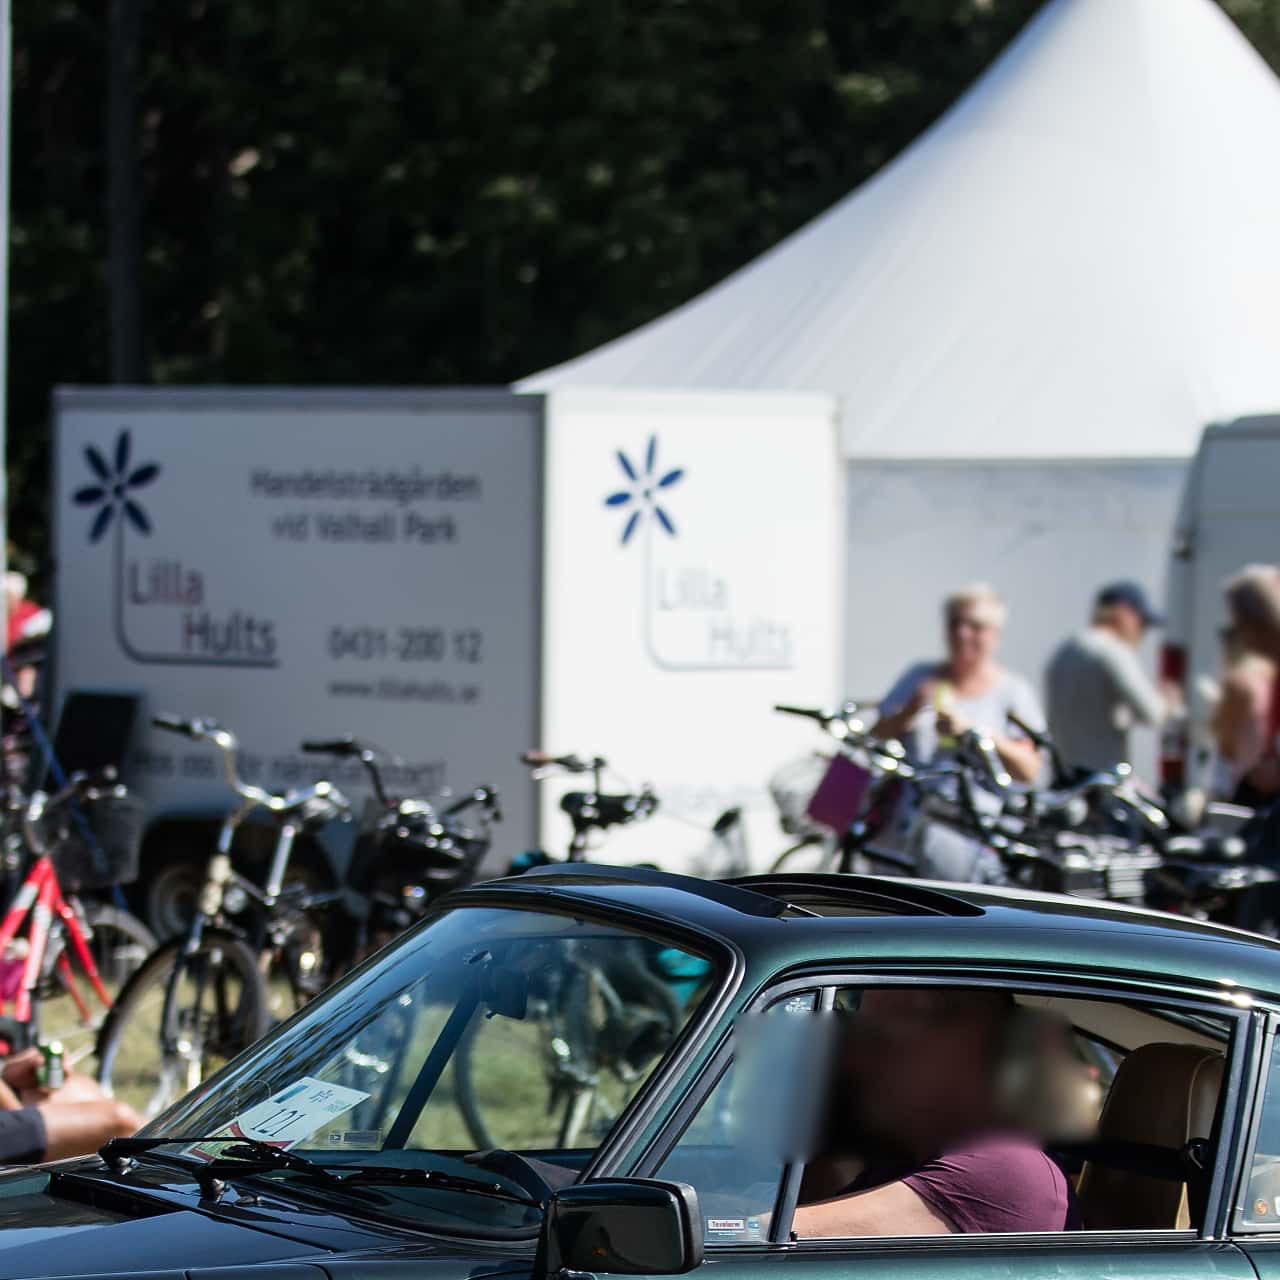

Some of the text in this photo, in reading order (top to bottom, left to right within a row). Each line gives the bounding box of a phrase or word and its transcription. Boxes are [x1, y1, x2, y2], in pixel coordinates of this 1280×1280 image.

[406, 512, 458, 544] Park
[128, 560, 204, 605] Lilla
[657, 567, 729, 611] Lilla
[182, 610, 277, 657] Hults
[453, 625, 483, 665] 12
[707, 616, 795, 664] Hults
[250, 1108, 307, 1138] 121
